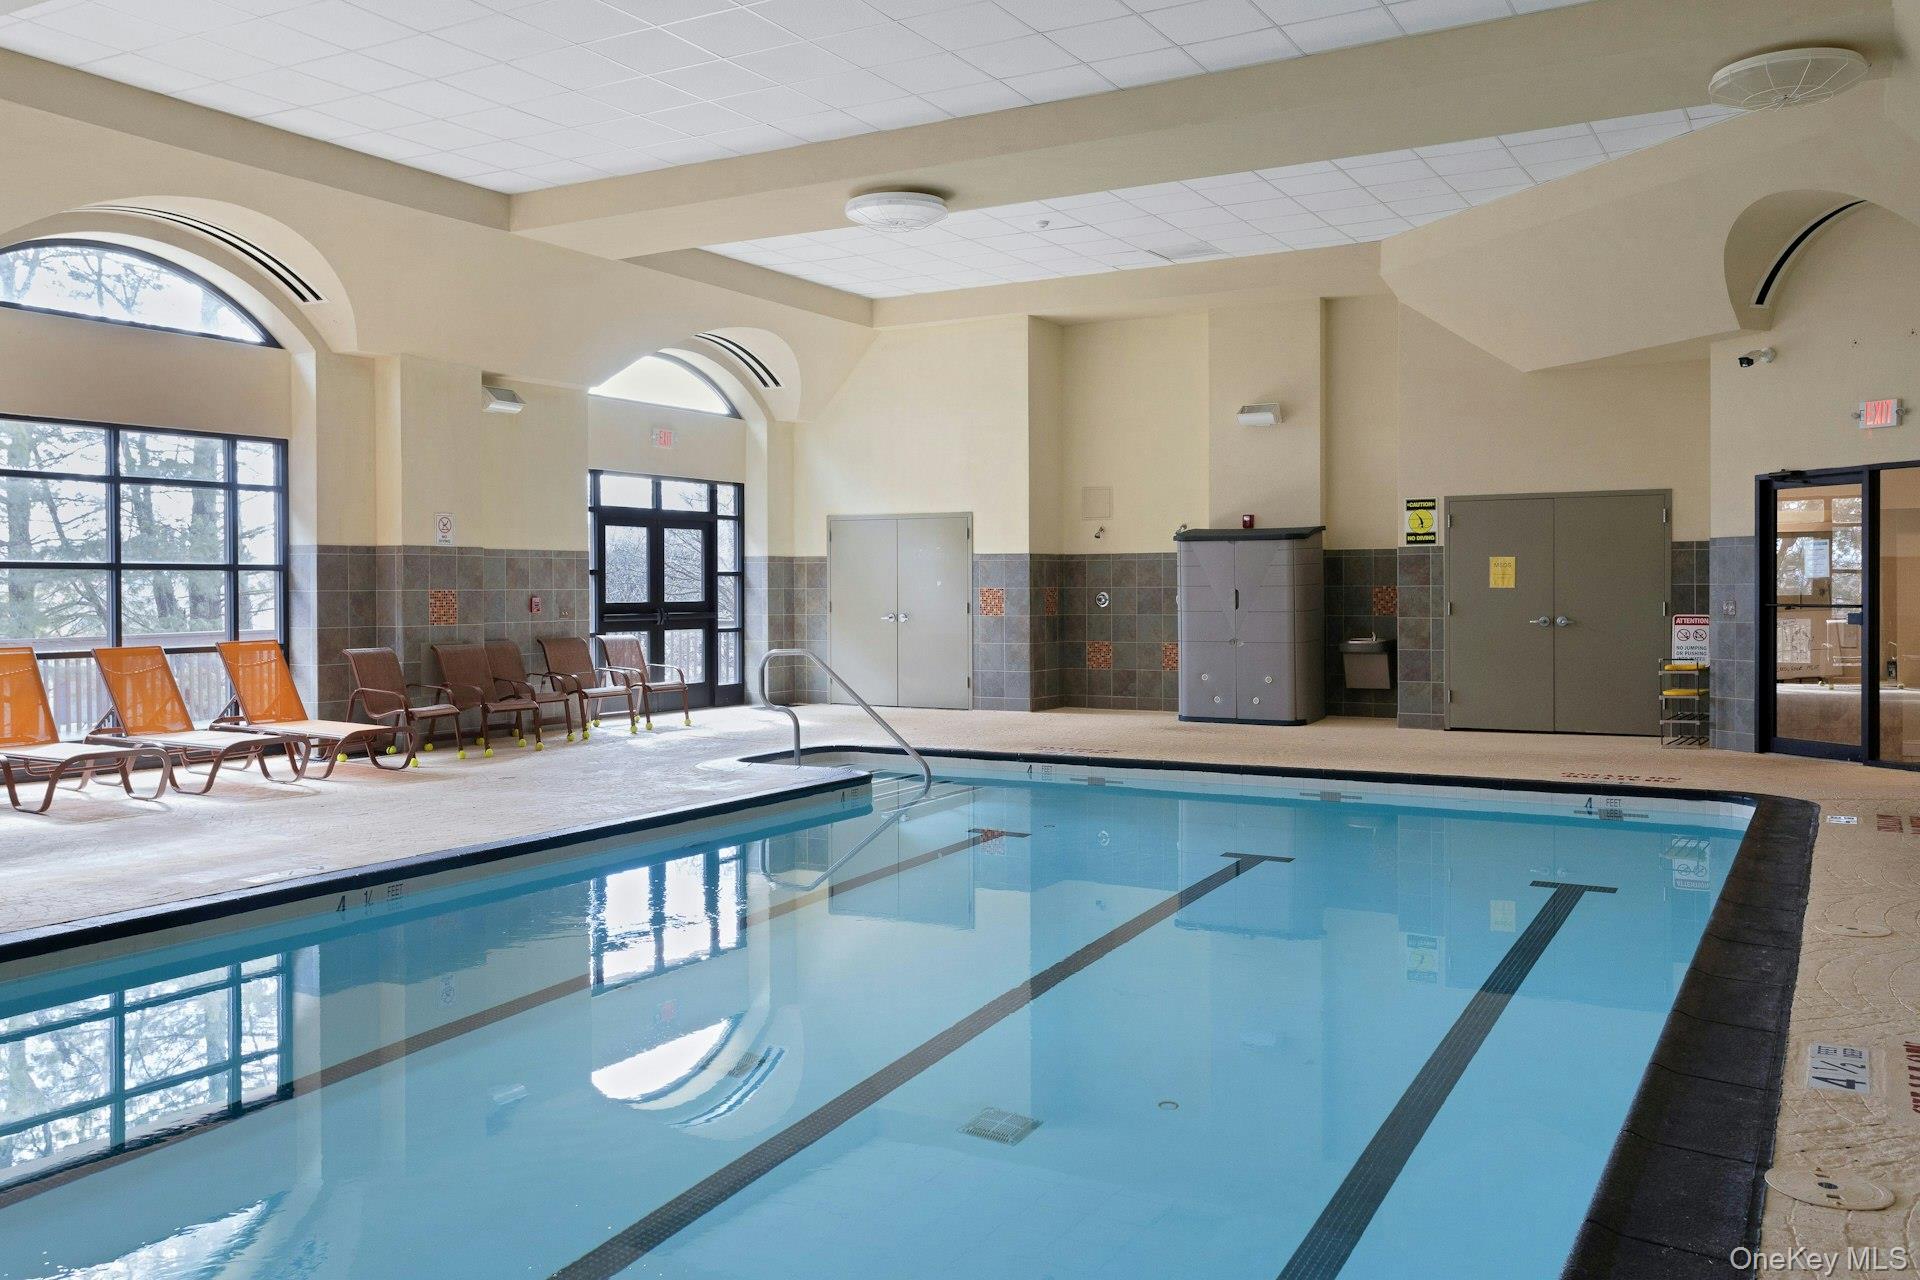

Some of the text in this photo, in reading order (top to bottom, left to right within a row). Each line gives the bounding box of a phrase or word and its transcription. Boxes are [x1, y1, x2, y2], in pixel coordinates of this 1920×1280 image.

[1866, 400, 1892, 425] EXIT
[1675, 617, 1709, 625] ATTENTION
[1606, 799, 1622, 807] FEET
[1811, 1075, 1867, 1090] 4
